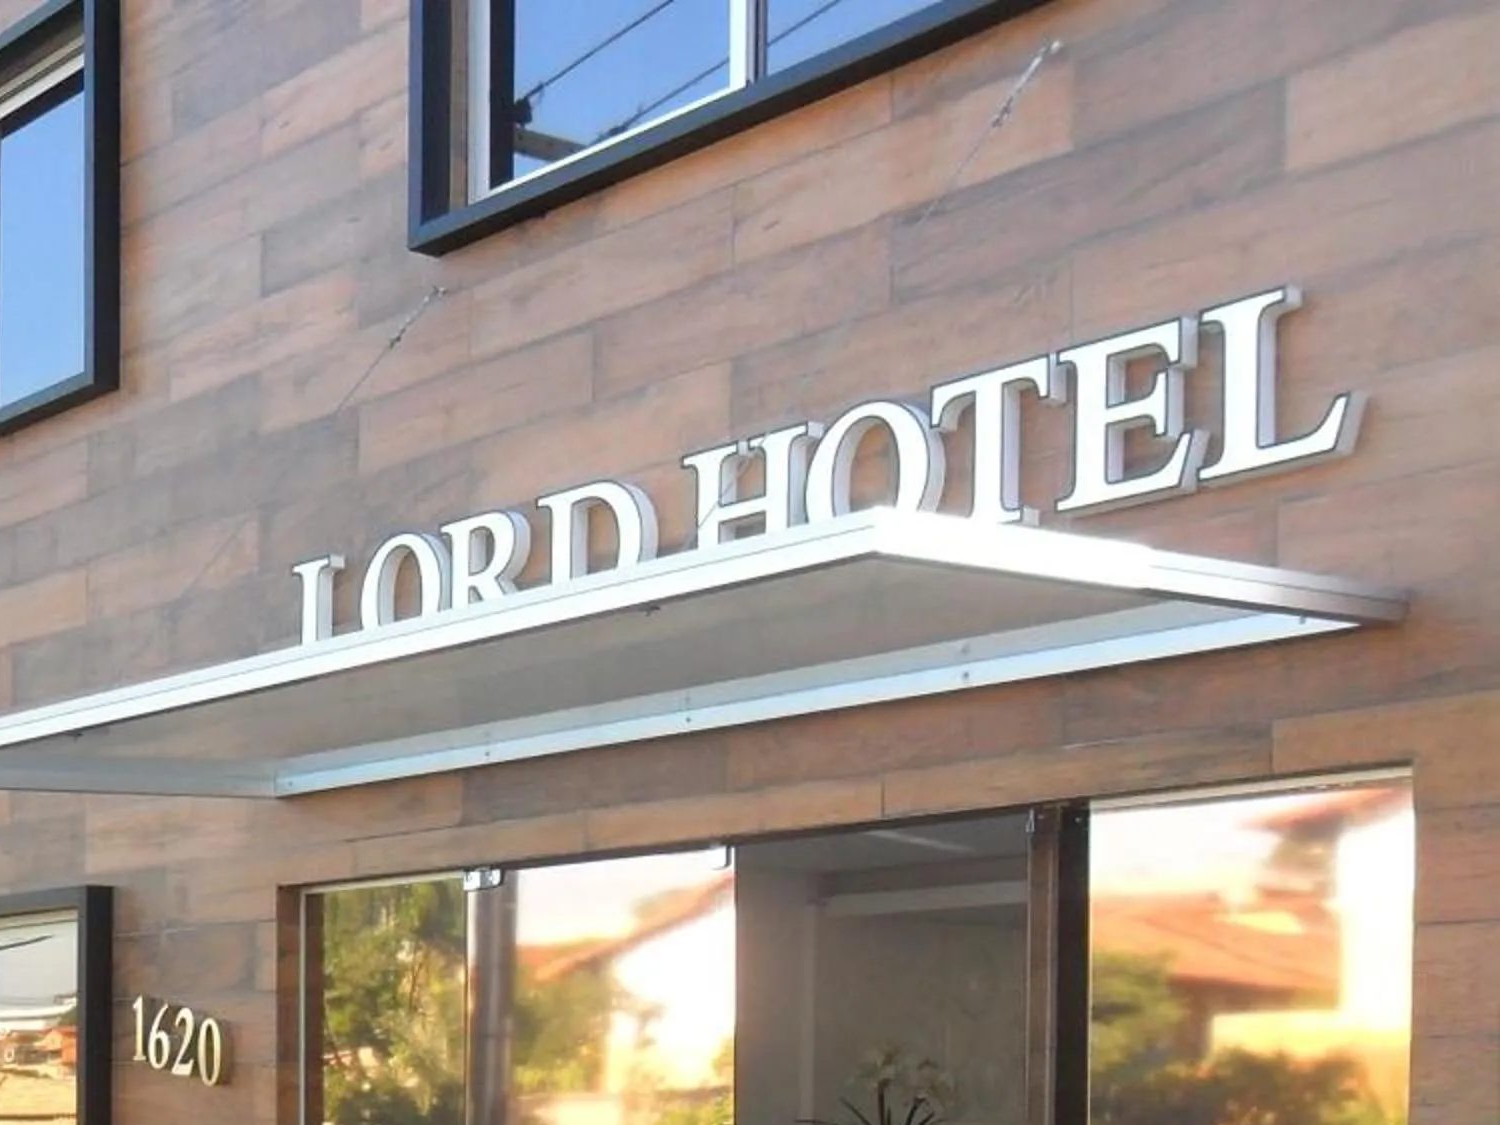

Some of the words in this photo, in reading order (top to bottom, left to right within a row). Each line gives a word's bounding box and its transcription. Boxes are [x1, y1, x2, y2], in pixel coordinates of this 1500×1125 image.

[292, 478, 658, 646] LORD
[681, 284, 1366, 548] HOTEL
[132, 995, 221, 1086] 1620
